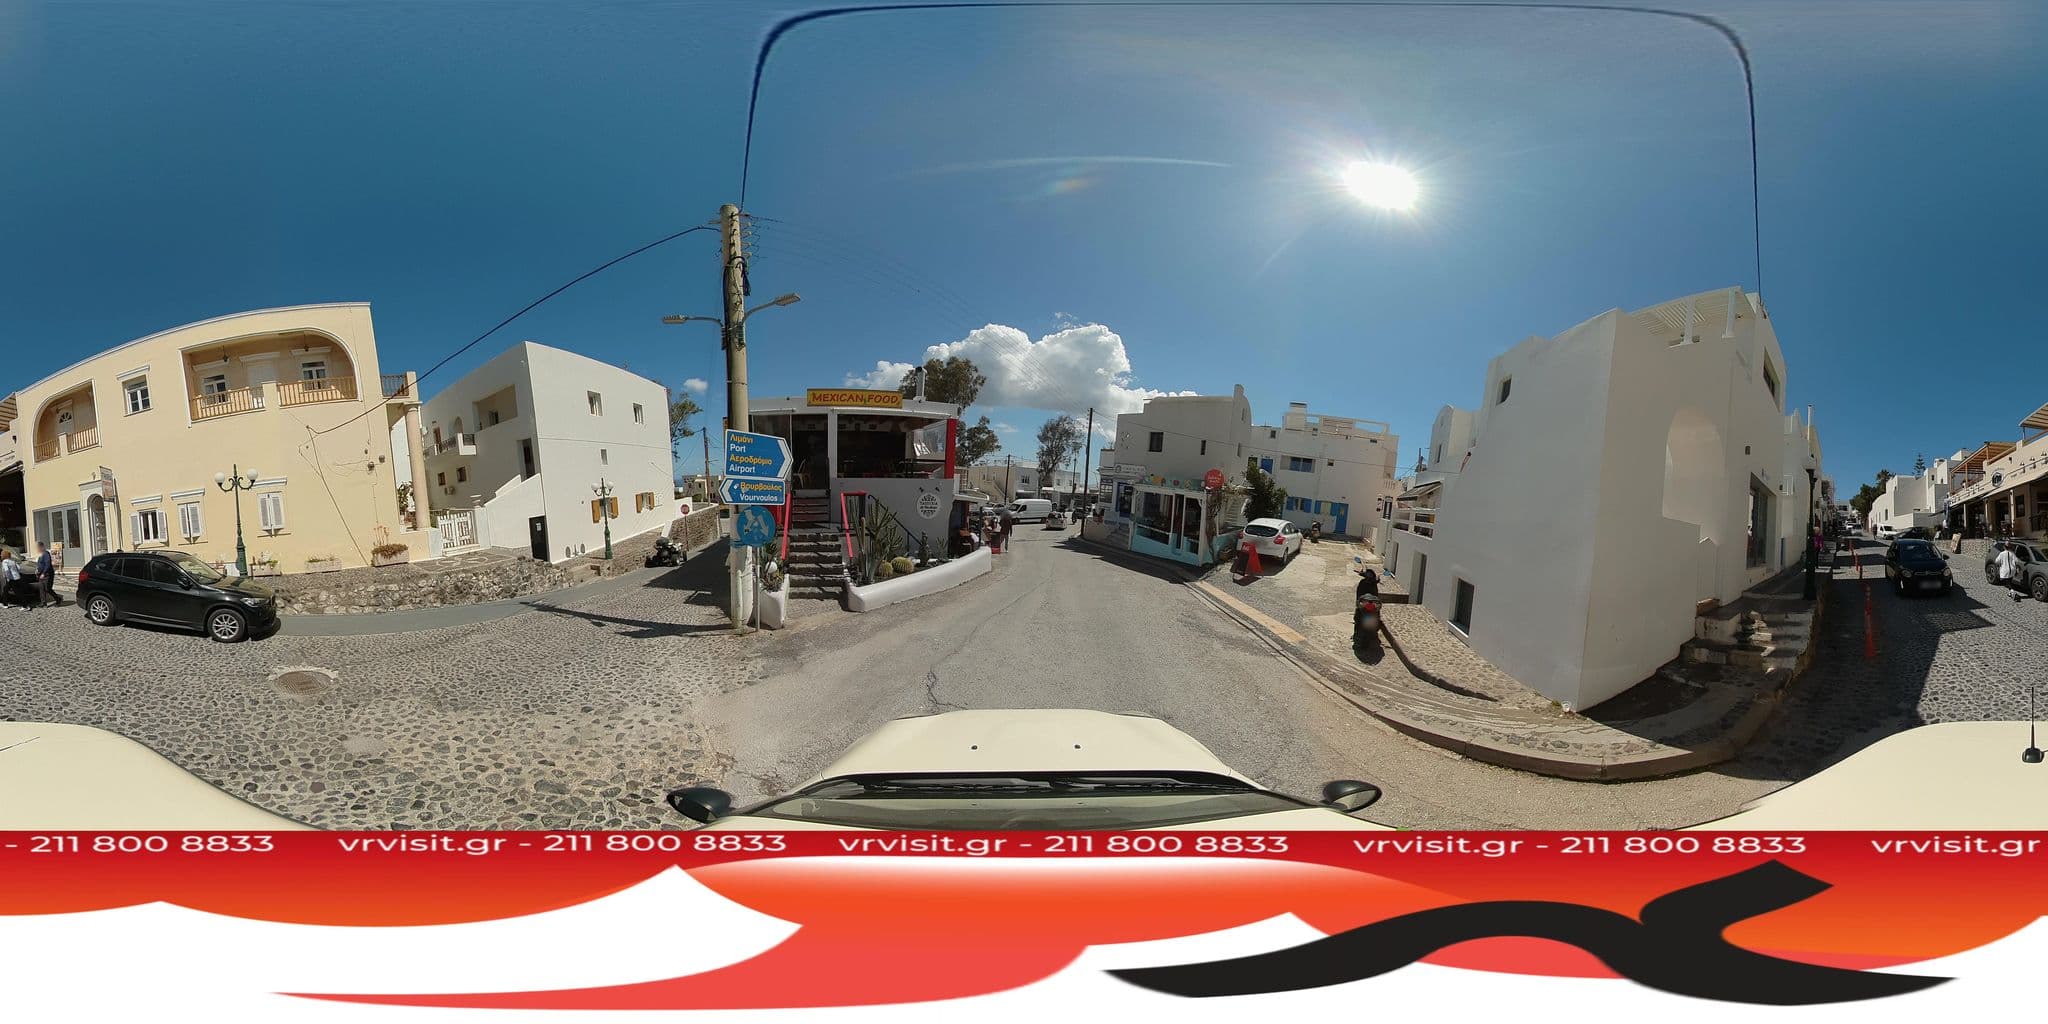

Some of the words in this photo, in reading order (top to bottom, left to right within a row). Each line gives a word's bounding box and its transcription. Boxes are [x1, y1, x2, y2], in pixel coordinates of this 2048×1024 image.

[812, 392, 864, 403] MEXICAN
[867, 394, 899, 404] FOOD
[729, 443, 746, 452] Port
[729, 454, 772, 465] Αεροδρόμιο
[729, 464, 755, 473] Airport
[739, 493, 778, 502] Vourvoulos
